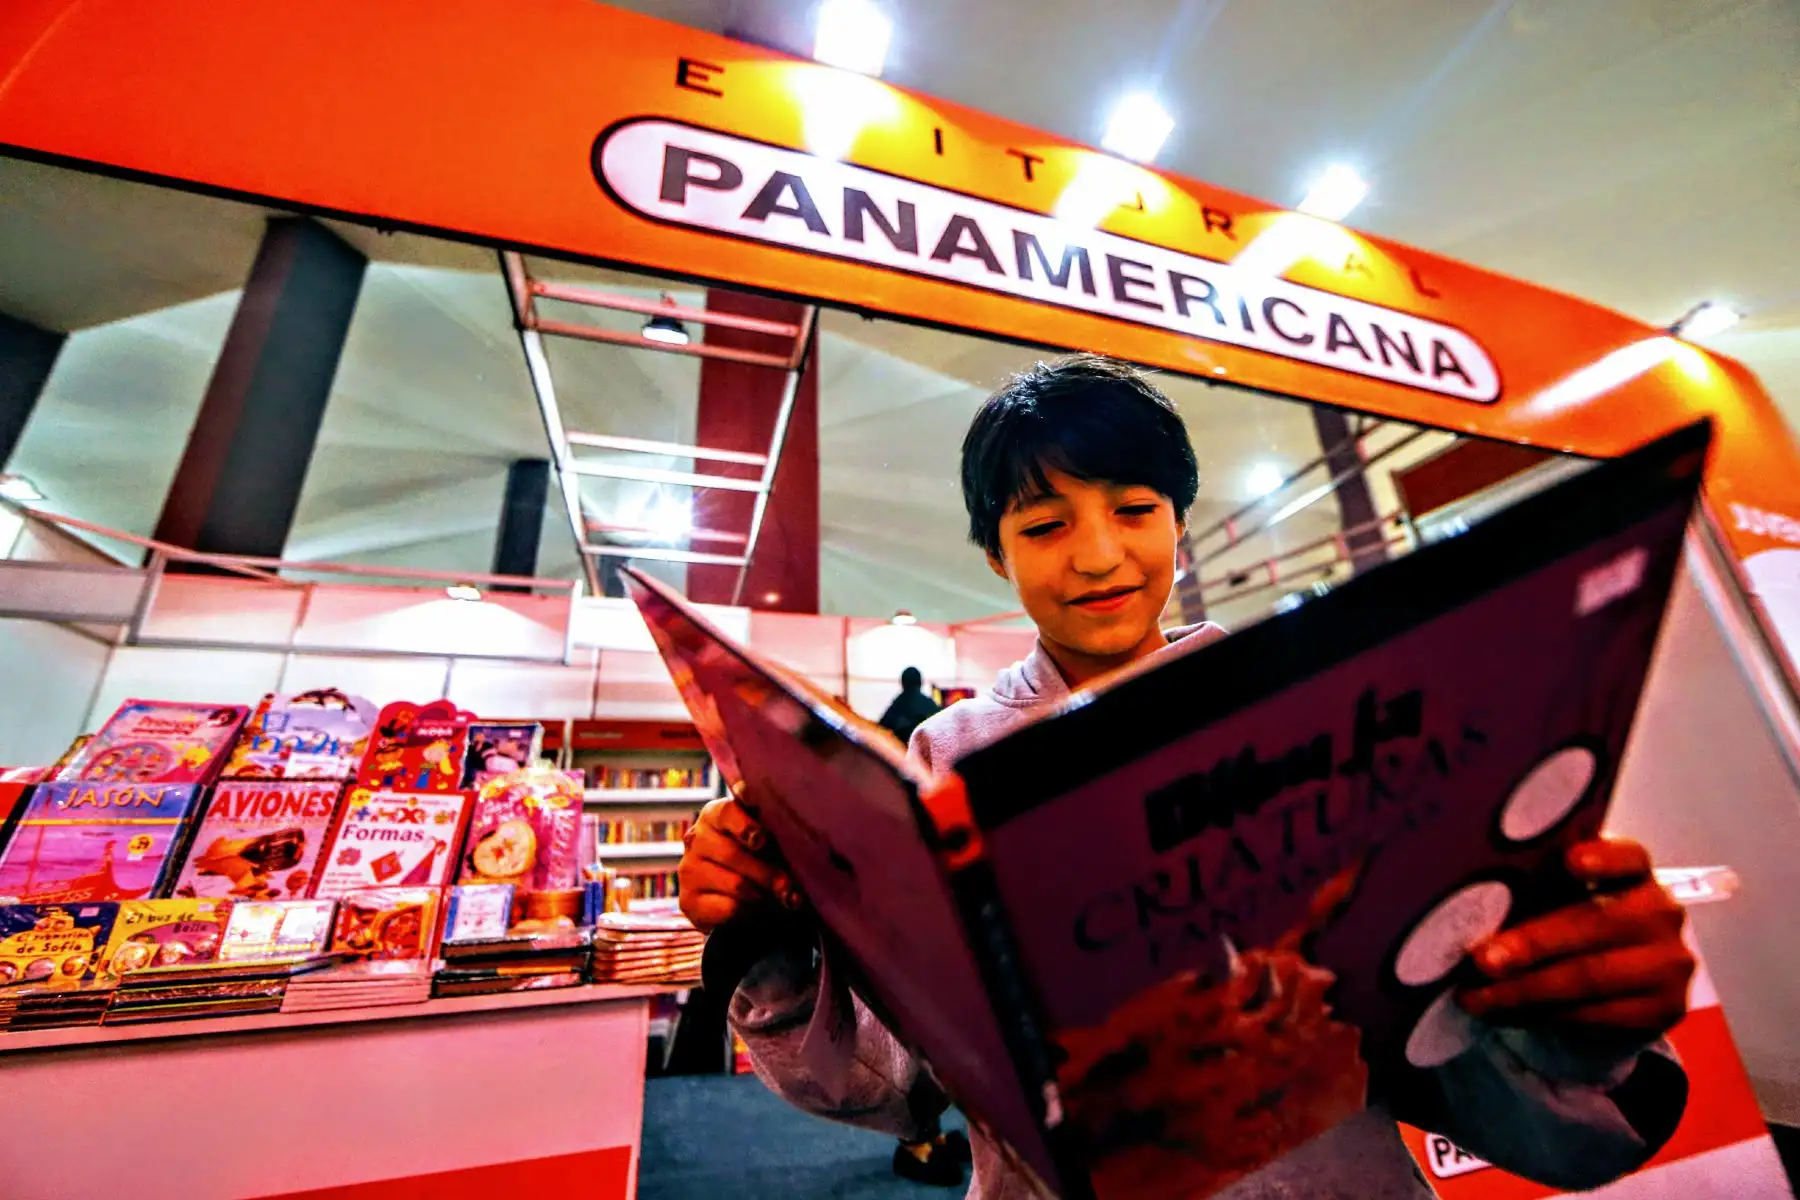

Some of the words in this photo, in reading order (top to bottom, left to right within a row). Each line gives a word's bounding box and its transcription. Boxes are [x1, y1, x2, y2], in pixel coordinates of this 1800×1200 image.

[659, 144, 1476, 389] PANAMERICANA
[207, 791, 336, 817] AVIONES
[341, 823, 425, 841] Formas
